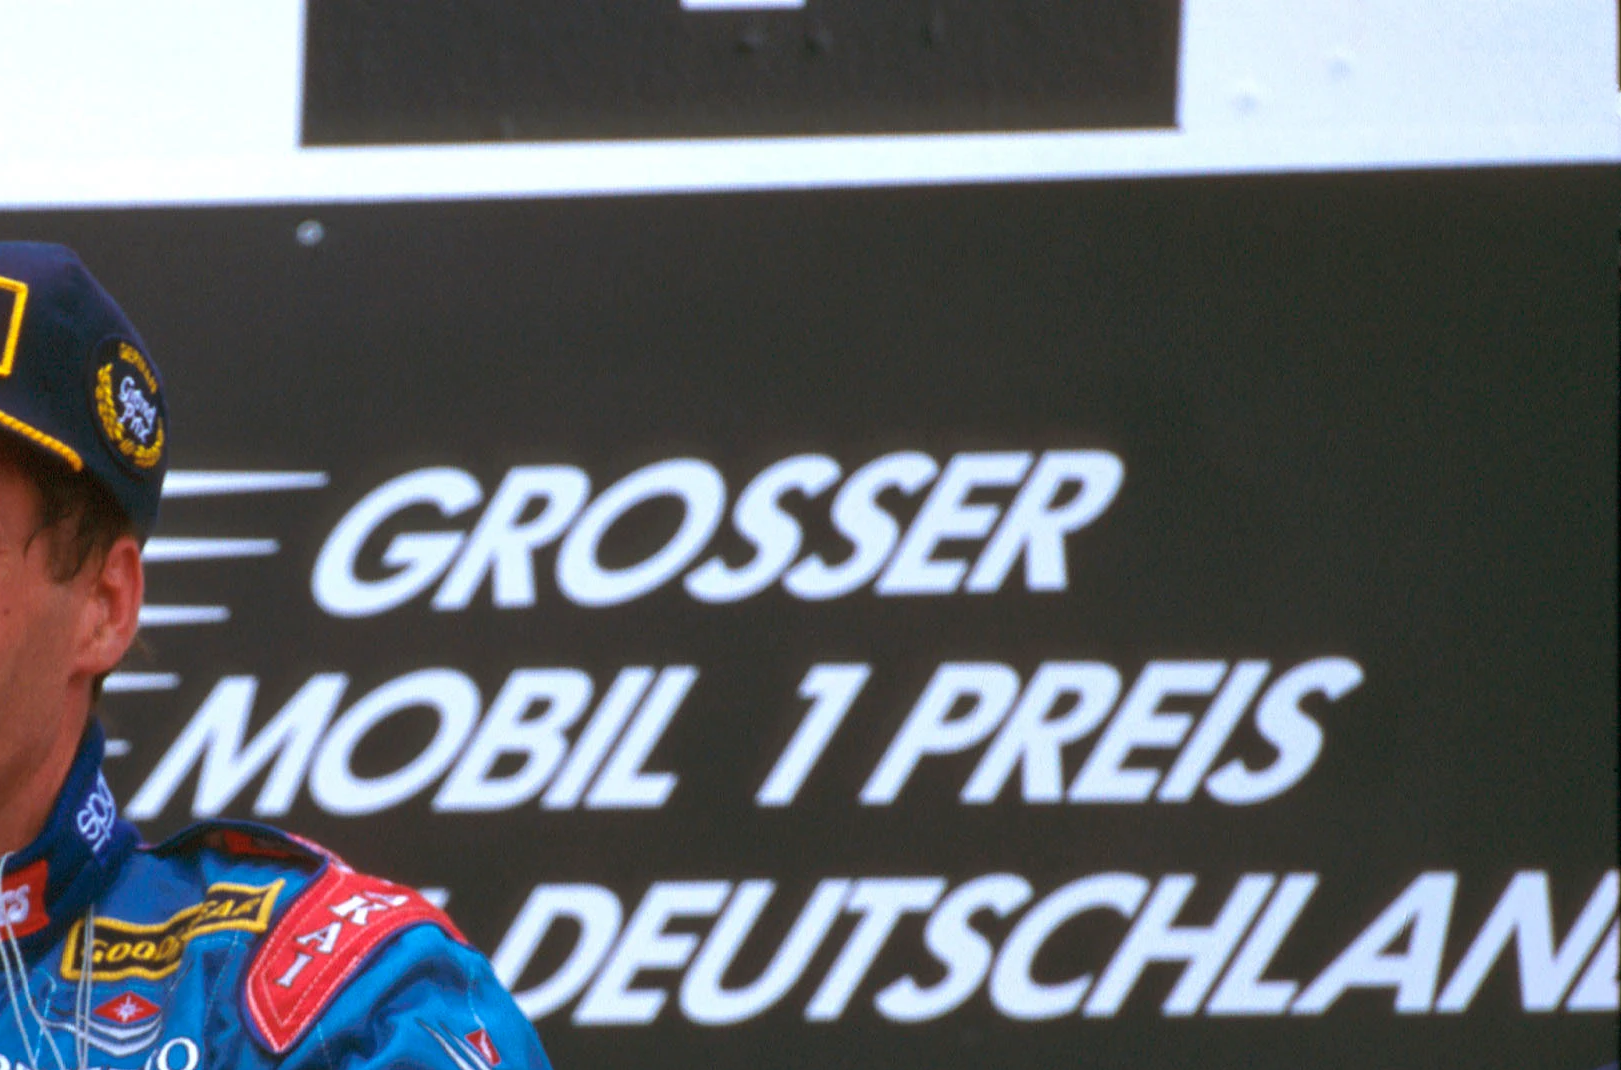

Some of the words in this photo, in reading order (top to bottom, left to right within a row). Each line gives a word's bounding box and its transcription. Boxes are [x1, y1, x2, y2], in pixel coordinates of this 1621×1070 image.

[311, 450, 1125, 619] GROSSER
[124, 664, 698, 818] MOBIL
[755, 662, 872, 806] 1
[858, 656, 1365, 805] PREIS
